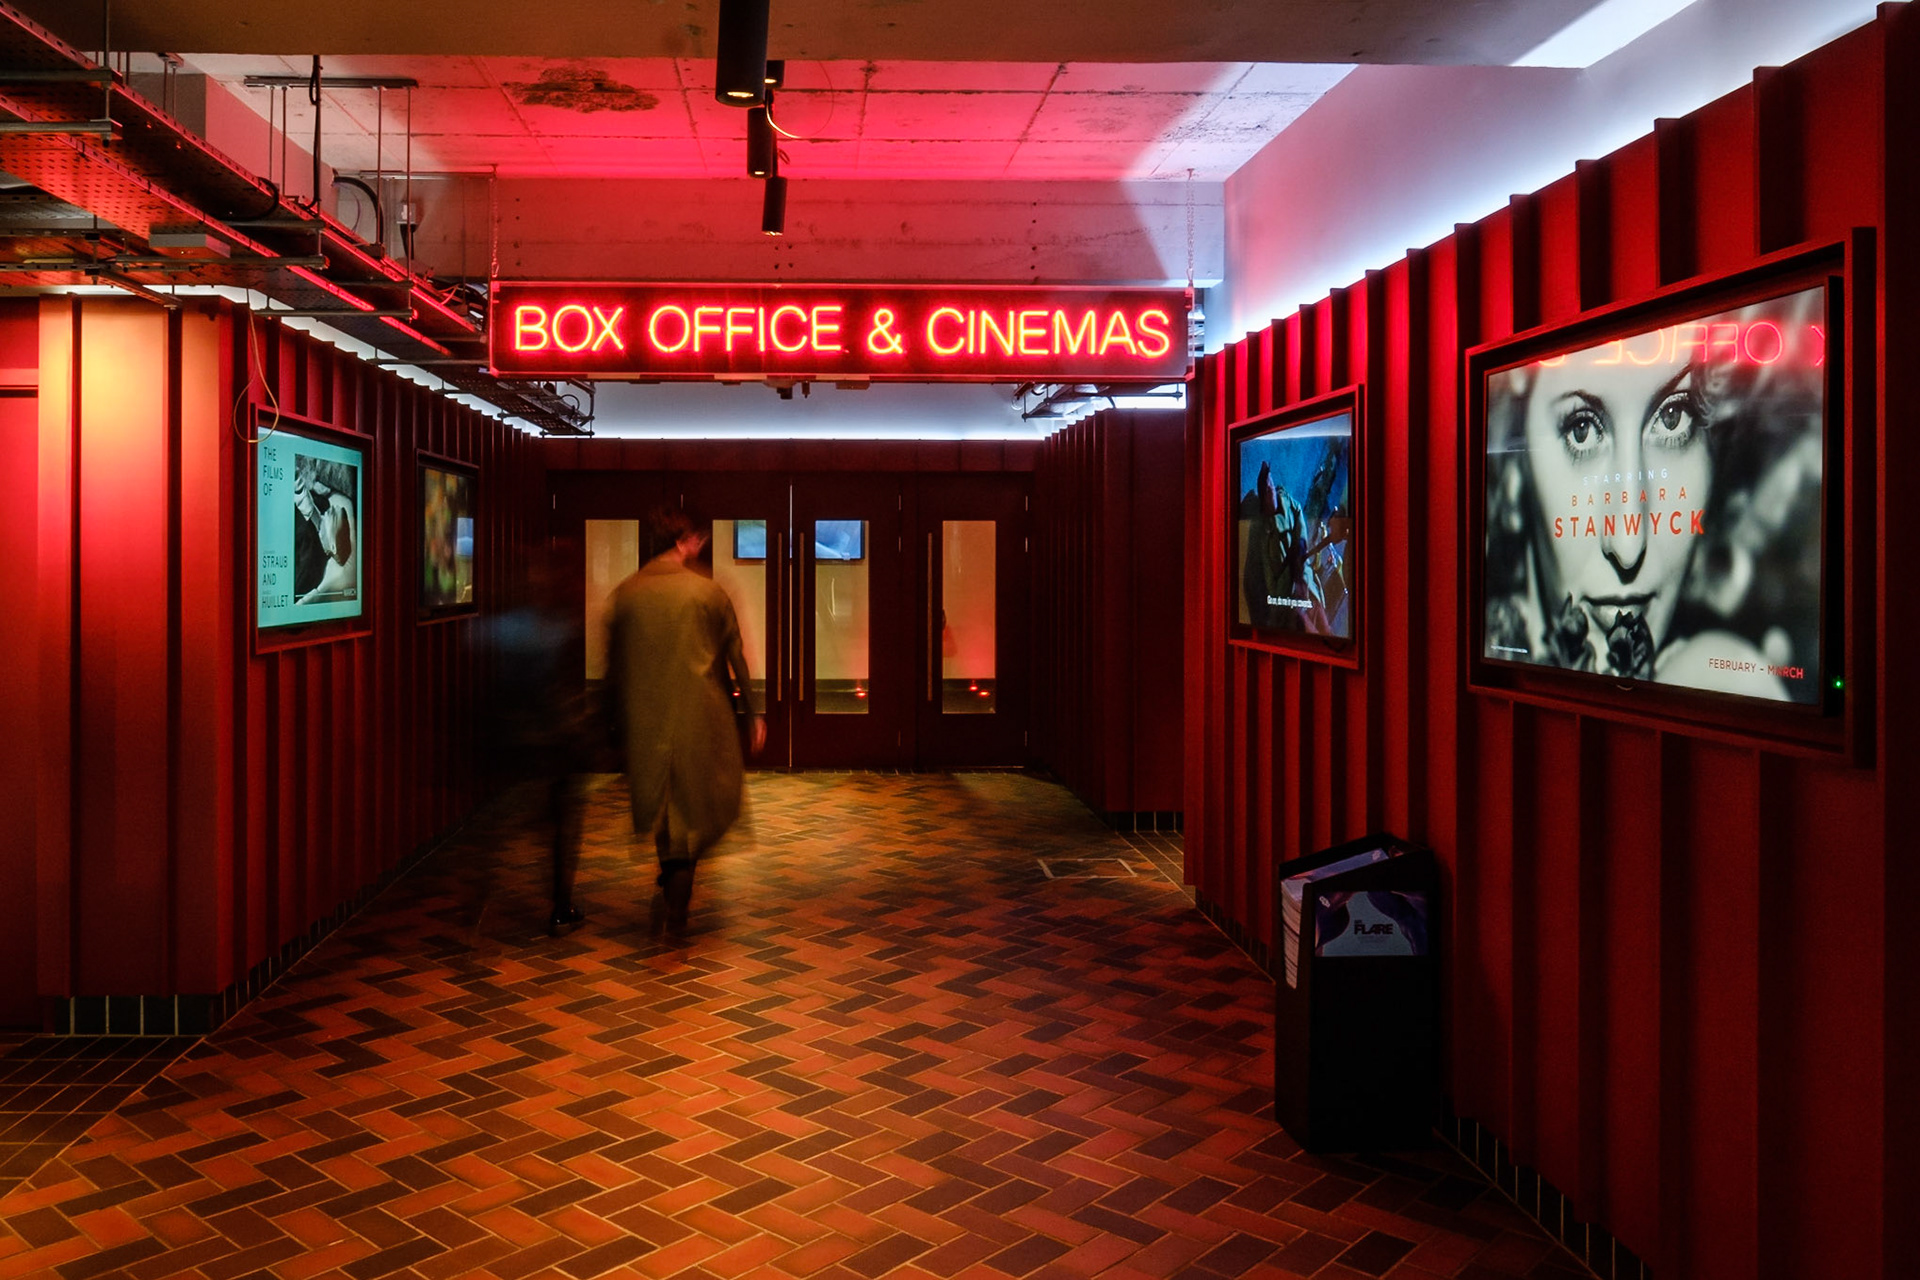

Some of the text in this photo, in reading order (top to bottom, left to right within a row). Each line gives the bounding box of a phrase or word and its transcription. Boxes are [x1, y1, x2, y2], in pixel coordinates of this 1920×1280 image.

[513, 304, 1171, 358] BOX OFFICE & CINEMAS
[263, 446, 277, 462] THE
[263, 464, 284, 480] FILMS
[1582, 467, 1669, 487] STARRING
[263, 482, 273, 496] OF
[1571, 486, 1688, 507] BARBARA
[1553, 509, 1706, 539] STANWYCK
[262, 555, 288, 568] STRAUB
[262, 573, 276, 586] AND
[1708, 657, 1757, 674] FEBRUARY
[1767, 664, 1804, 680] MARCH
[1354, 923, 1393, 935] FLARE
